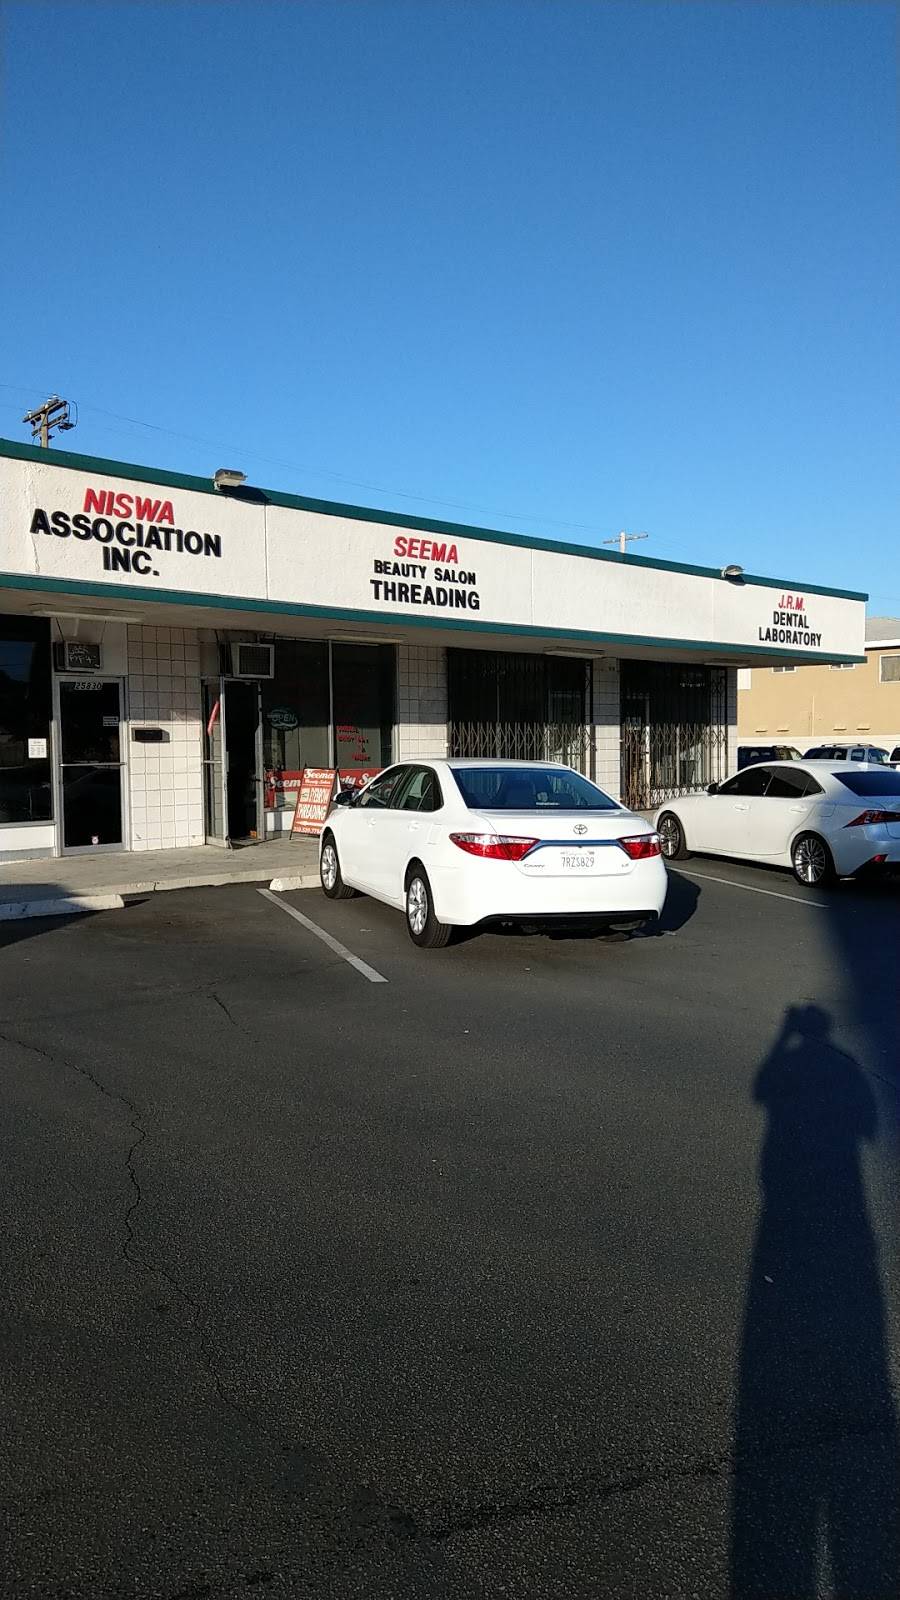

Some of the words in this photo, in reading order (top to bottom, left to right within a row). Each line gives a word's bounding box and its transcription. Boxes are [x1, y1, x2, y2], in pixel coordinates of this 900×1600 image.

[83, 488, 175, 525] NISWA
[30, 508, 222, 557] ASSOCIATION
[393, 536, 458, 564] SEEMA
[102, 546, 160, 576] INC.
[374, 559, 427, 579] BEAUTY
[434, 567, 476, 585] SALON
[370, 579, 480, 610] THREADING
[773, 611, 809, 629] DENTAL
[758, 626, 822, 647] LABORATORY
[75, 682, 102, 690] 25830
[271, 713, 296, 722] OPEN
[270, 776, 301, 788] Seem
[303, 769, 335, 779] Seema
[297, 803, 327, 821] THREADING
